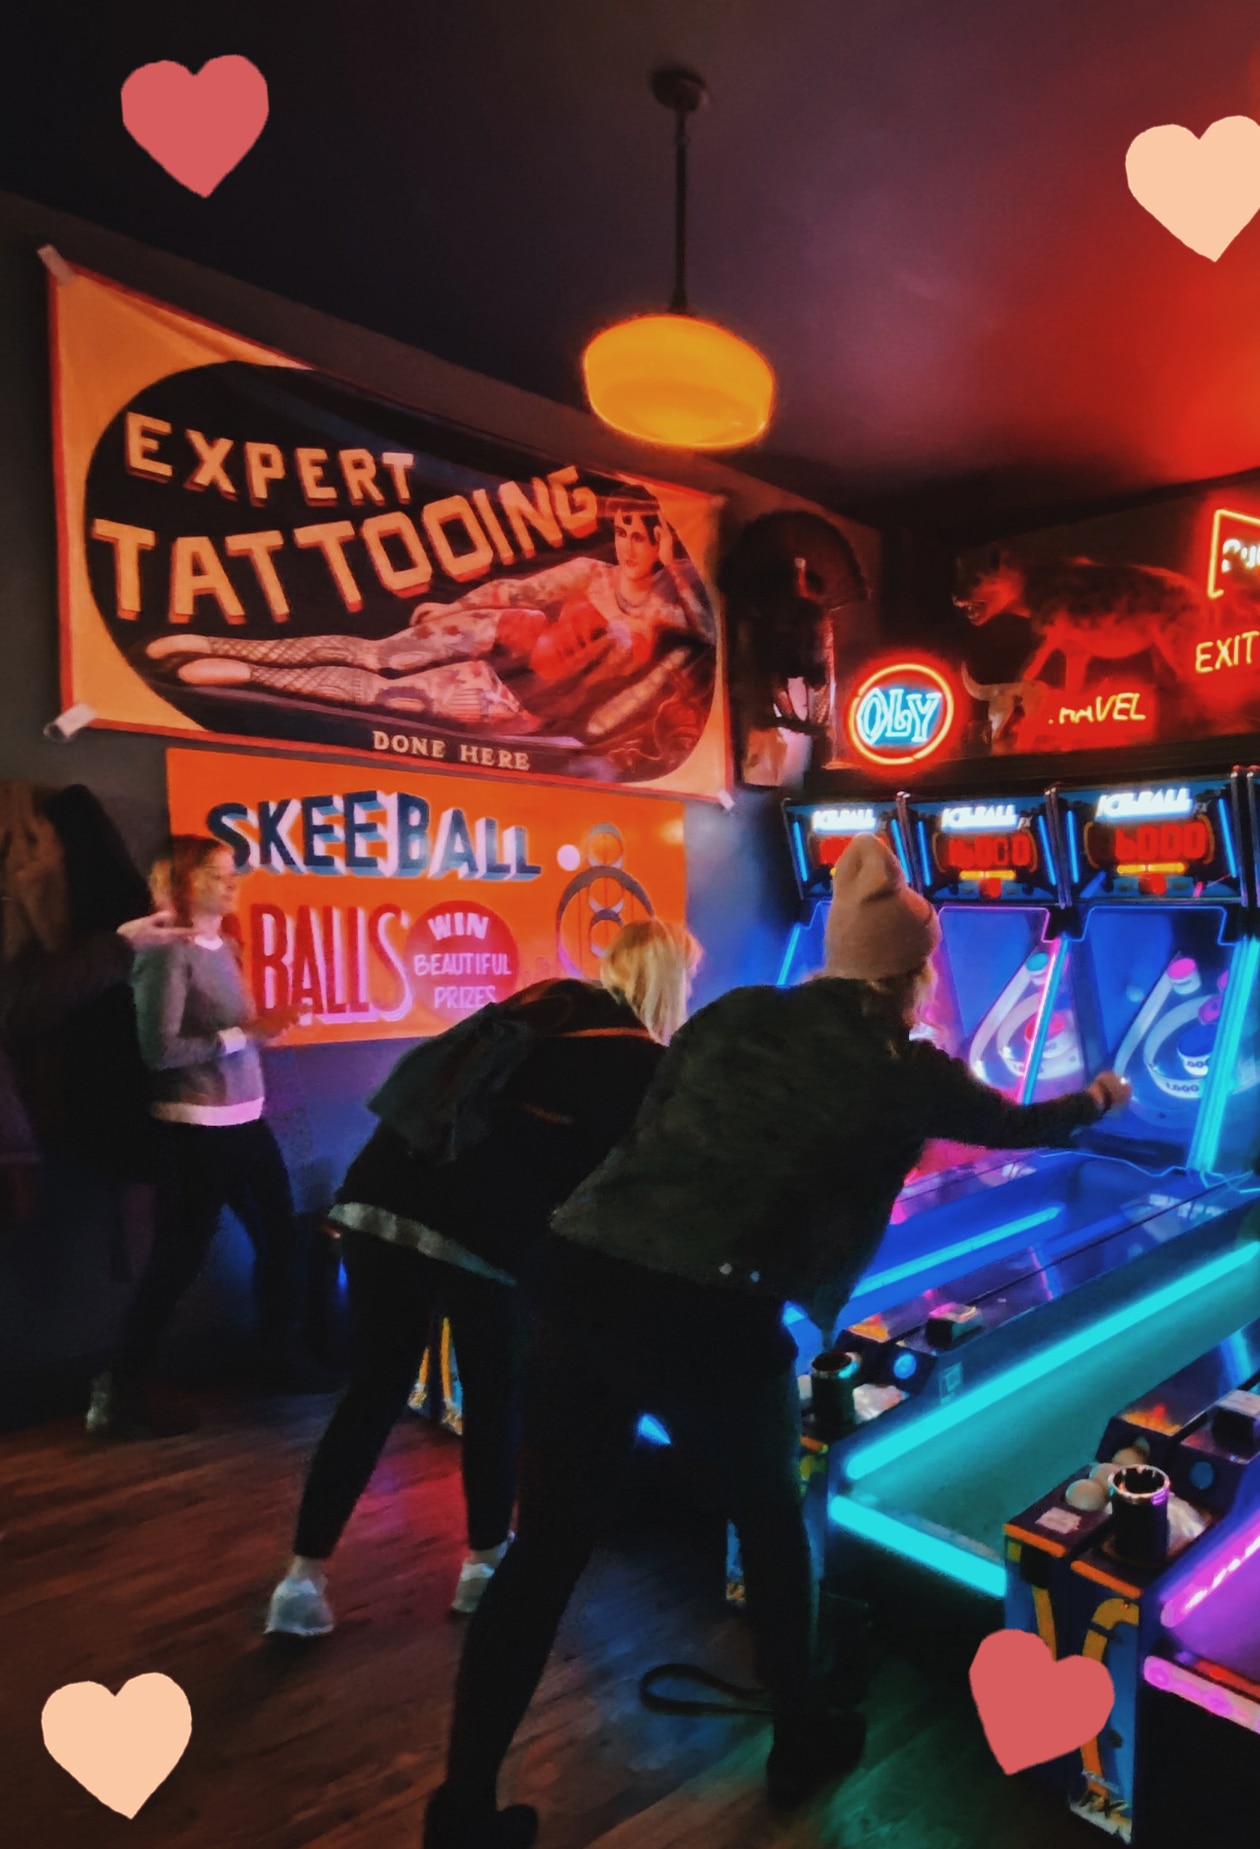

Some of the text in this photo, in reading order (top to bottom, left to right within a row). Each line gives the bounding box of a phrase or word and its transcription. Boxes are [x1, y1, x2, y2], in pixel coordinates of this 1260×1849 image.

[124, 411, 414, 507] EXPERT
[92, 465, 598, 626] TATTOOING
[1195, 631, 1260, 673] EXIT
[856, 687, 942, 746] OLY
[372, 730, 530, 771] DONE HERE
[427, 912, 489, 941] WIN
[251, 903, 413, 1025] BALLS
[413, 953, 512, 976] BEAUTIFUL
[434, 985, 497, 1009] PRIZES
